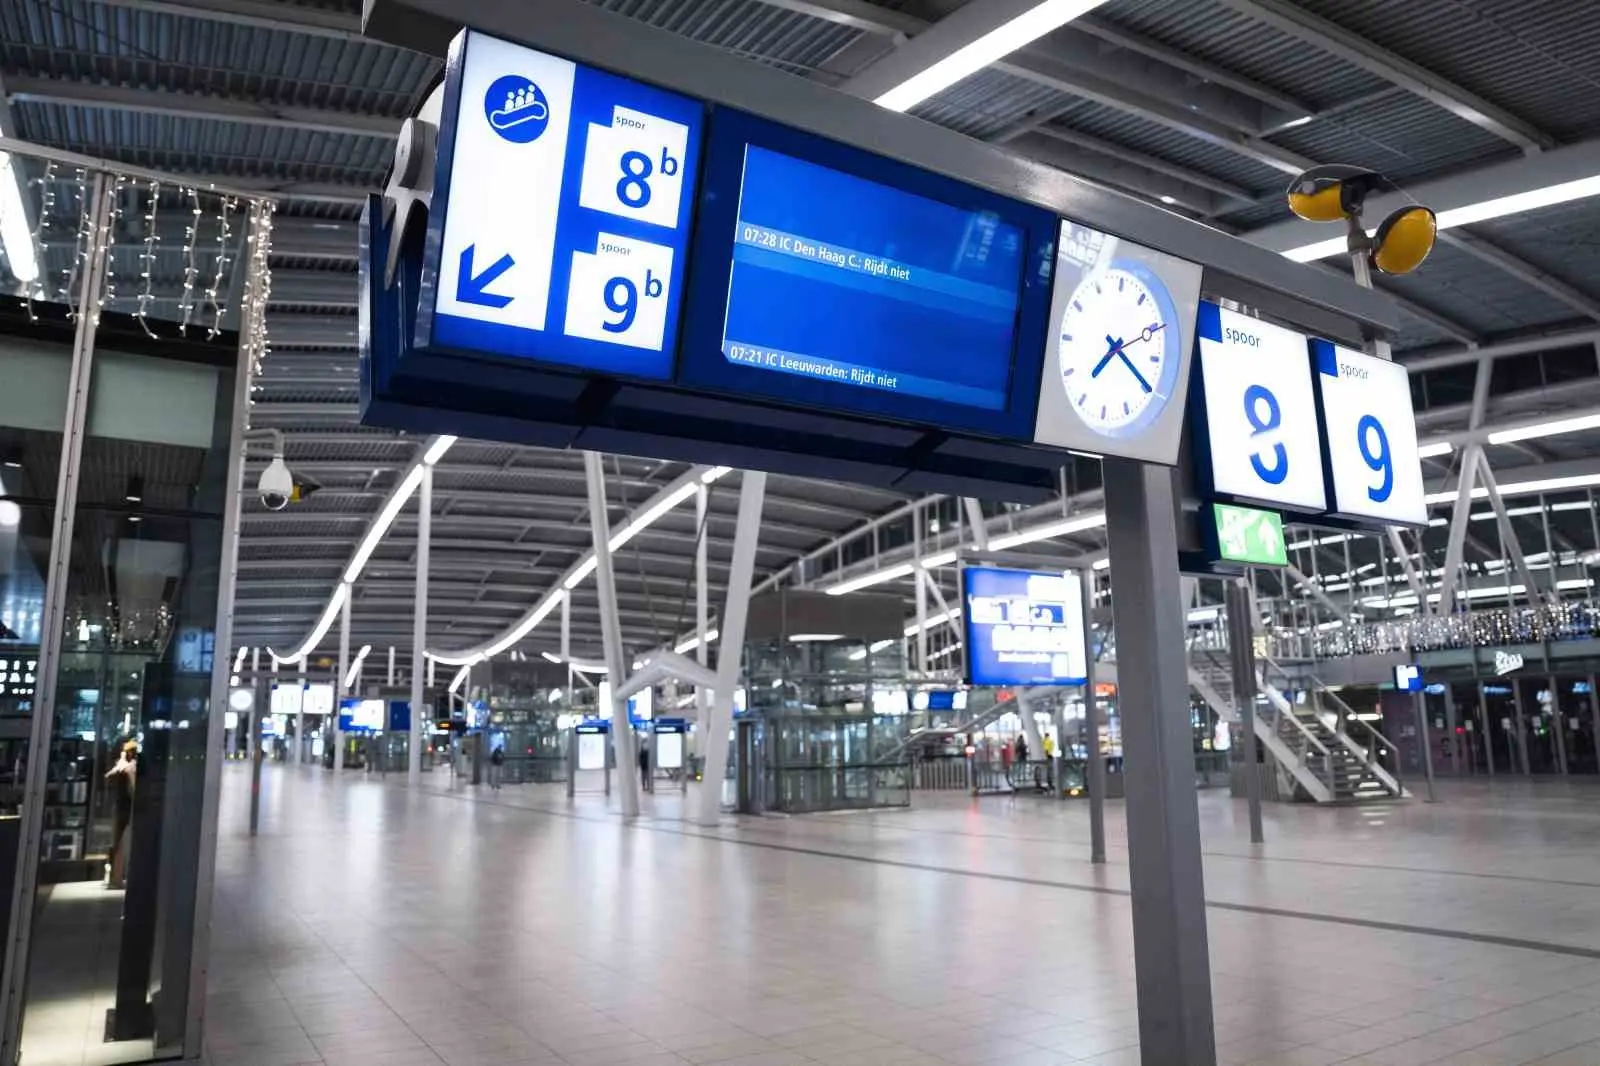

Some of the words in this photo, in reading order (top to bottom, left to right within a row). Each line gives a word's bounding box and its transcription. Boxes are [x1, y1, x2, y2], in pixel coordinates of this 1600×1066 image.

[616, 116, 646, 130] spoor
[601, 243, 631, 257] spoor
[744, 227, 776, 247] 07:28
[780, 236, 791, 250] IC
[794, 240, 815, 257] Den
[818, 246, 845, 267] Haag
[864, 257, 888, 276] Rijdt
[890, 265, 910, 281] niet
[1226, 327, 1261, 347] spoor
[730, 345, 762, 364] 07:21
[766, 351, 778, 367] IC
[780, 354, 848, 380] Leeuwarden:
[850, 368, 876, 385] Rijdt
[877, 374, 897, 389] niet
[1340, 363, 1369, 380] spoor
[1243, 384, 1289, 485] 8
[1357, 414, 1394, 503] 9
